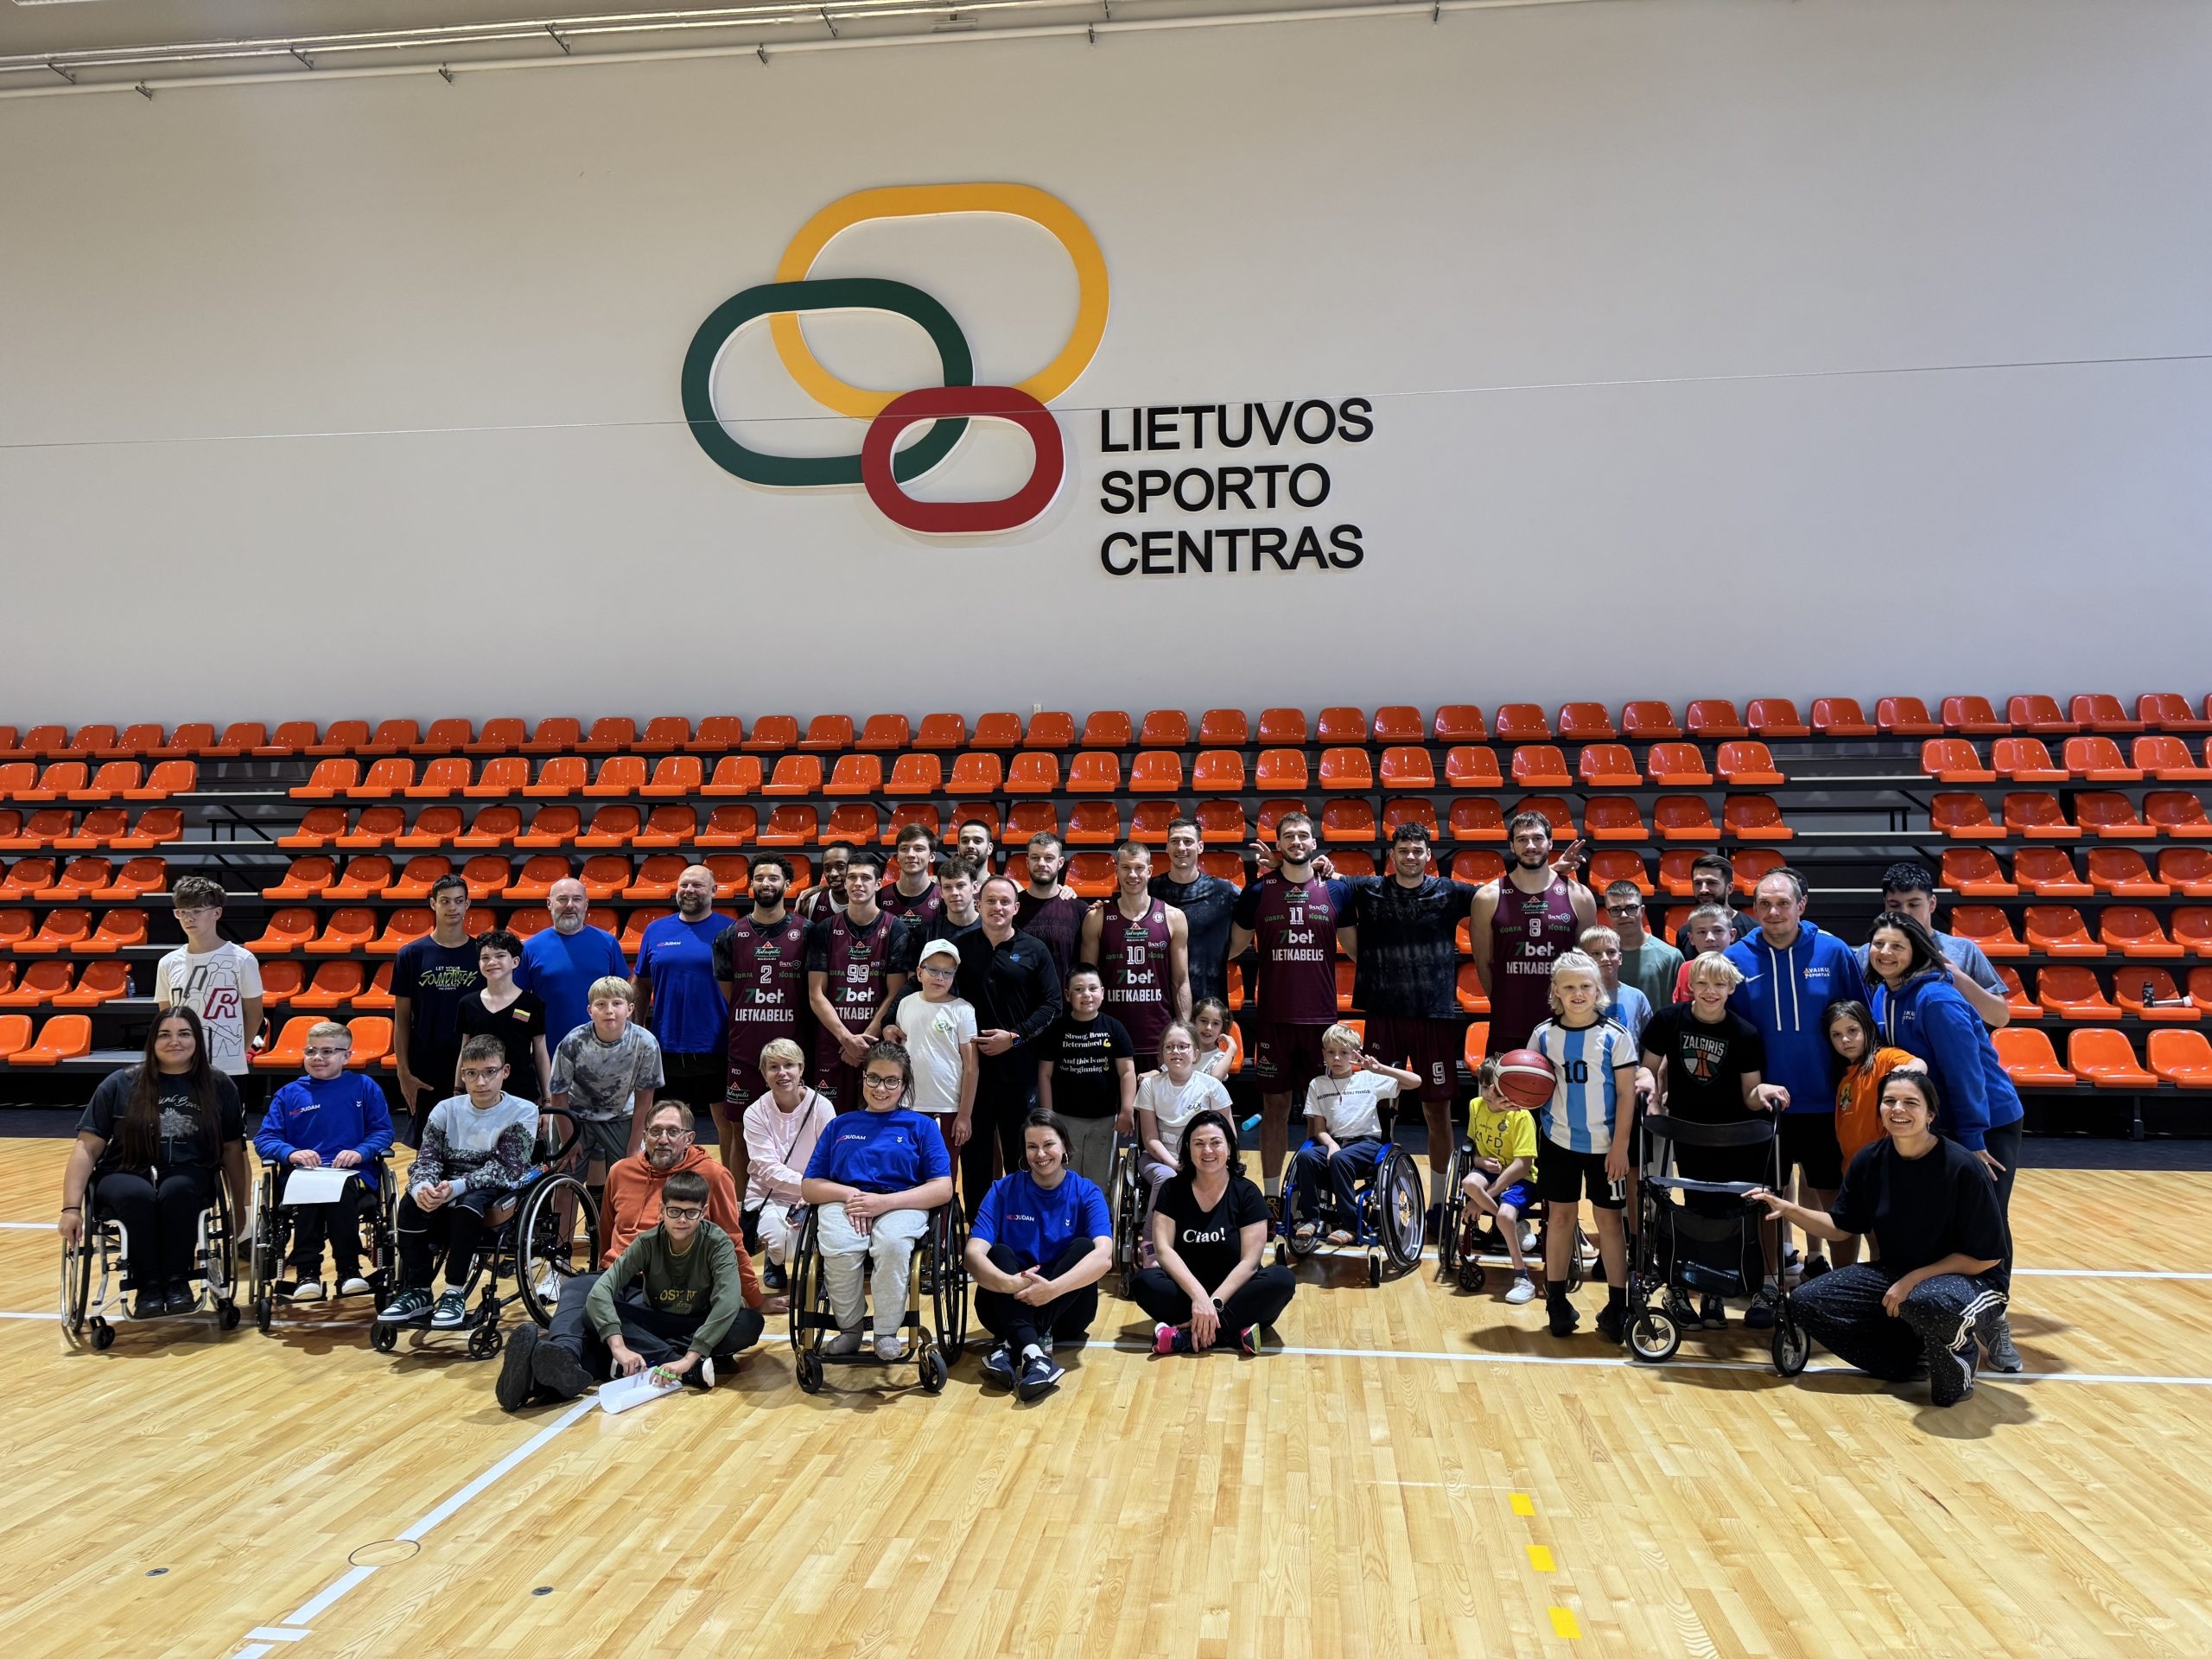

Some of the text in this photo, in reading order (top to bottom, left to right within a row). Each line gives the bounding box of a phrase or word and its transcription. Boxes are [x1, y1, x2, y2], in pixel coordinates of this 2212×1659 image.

[1101, 397, 1374, 452] LIETUVOS
[1100, 462, 1331, 514] SPORTO
[1100, 524, 1364, 576] CENTRAS
[1288, 906, 1305, 925] 11
[1529, 918, 1541, 938] 8
[1127, 946, 1145, 964] 10
[418, 969, 479, 987] SOUNDTRACK
[760, 965, 772, 984] 2
[847, 964, 869, 982] 99
[1108, 989, 1162, 1002] LIETKABELIS
[735, 1008, 794, 1021] LIETKABELIS
[1063, 1039, 1103, 1048] Determined
[1070, 1065, 1103, 1074] beginning
[1433, 1062, 1446, 1085] 9
[1561, 1060, 1588, 1084] 10
[1608, 1176, 1627, 1201] 10
[1183, 1227, 1226, 1243] Ciao!
